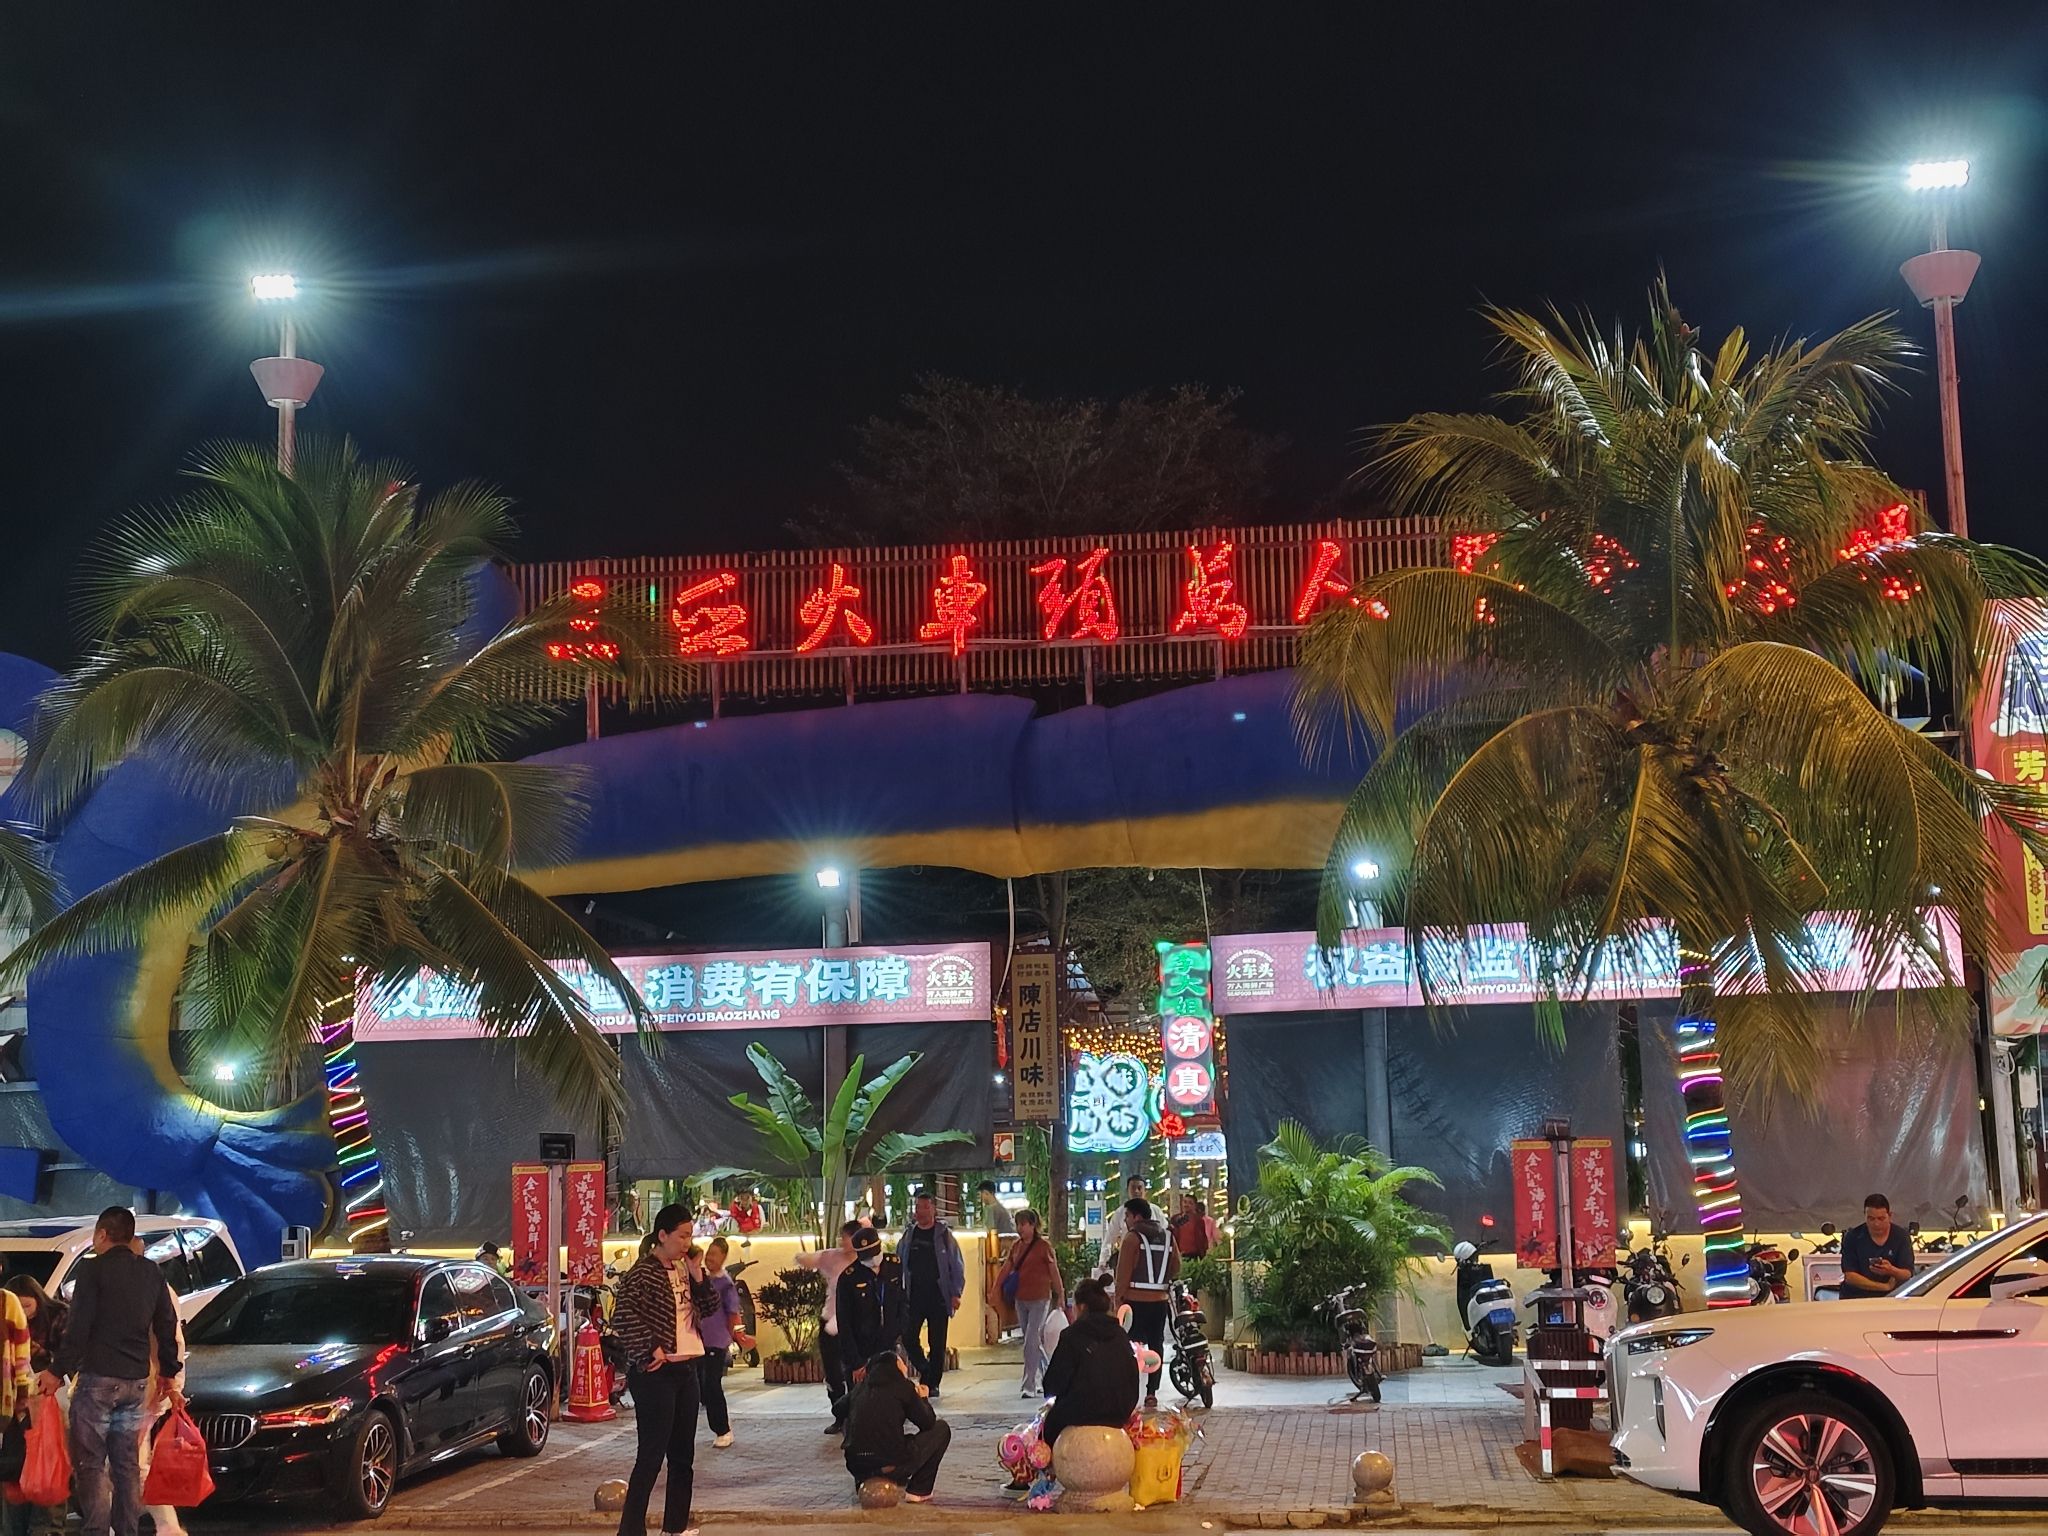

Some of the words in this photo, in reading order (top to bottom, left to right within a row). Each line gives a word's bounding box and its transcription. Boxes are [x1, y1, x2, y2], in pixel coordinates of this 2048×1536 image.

[926, 969, 974, 987] 火车头
[1226, 962, 1274, 980] 火车头
[1018, 982, 1045, 1088] 陳店川味
